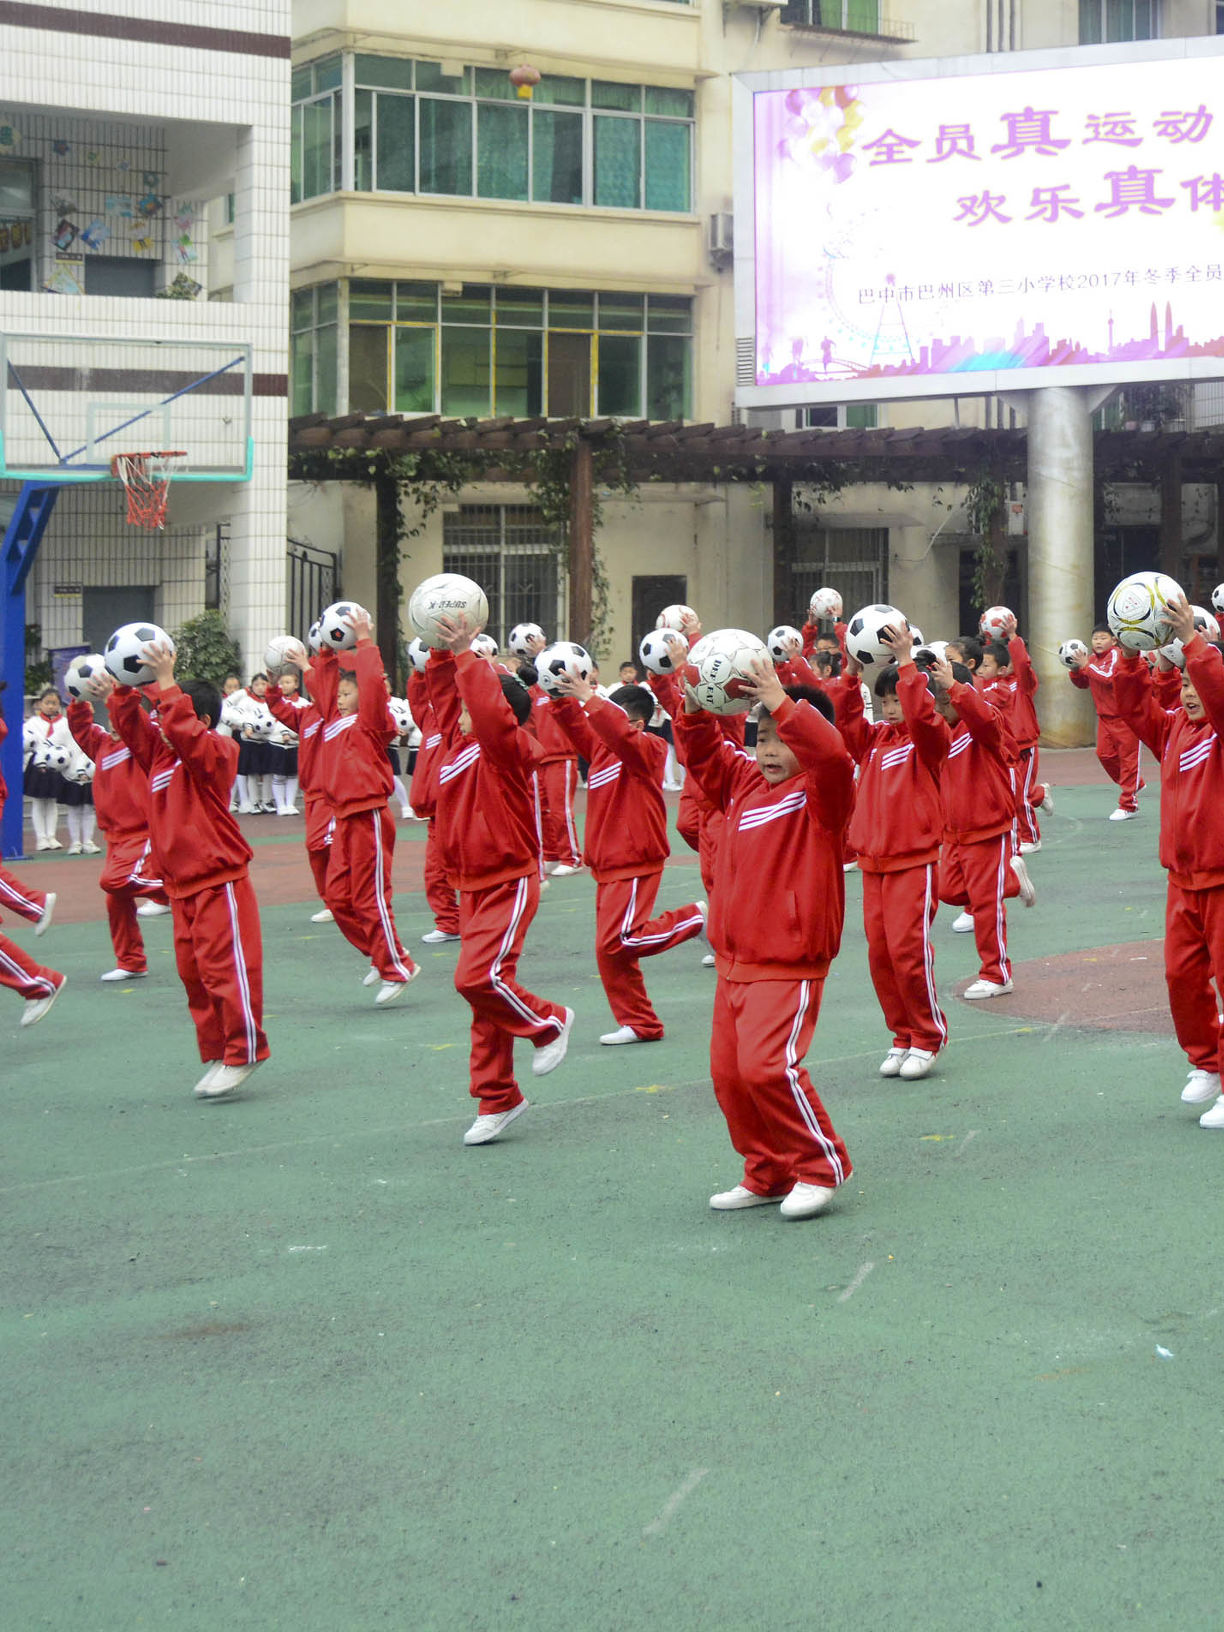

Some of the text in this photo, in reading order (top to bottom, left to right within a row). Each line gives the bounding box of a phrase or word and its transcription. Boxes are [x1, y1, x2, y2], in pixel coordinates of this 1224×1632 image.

[862, 104, 1214, 167] 全员真运动
